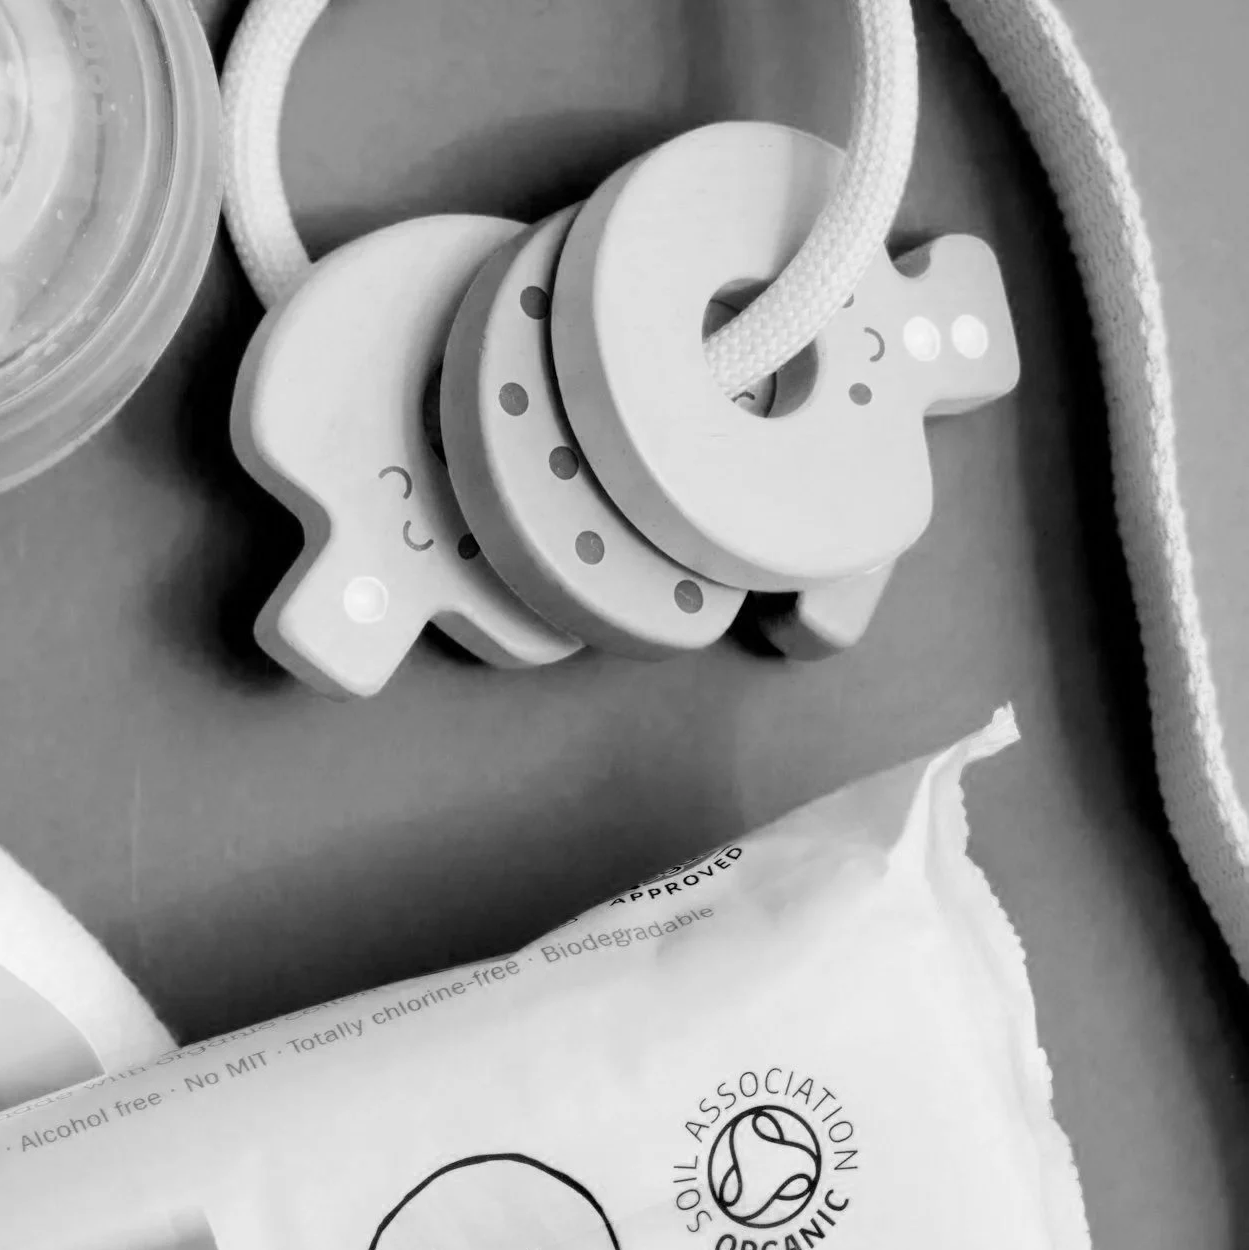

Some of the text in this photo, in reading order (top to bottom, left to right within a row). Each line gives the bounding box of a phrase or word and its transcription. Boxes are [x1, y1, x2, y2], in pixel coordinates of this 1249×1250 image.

[610, 847, 743, 906] APPROVED
[21, 1107, 110, 1152] Alcohol
[115, 1090, 163, 1117] free
[183, 1071, 220, 1093] No
[225, 1050, 268, 1078] MIT
[286, 1018, 364, 1055] Totally
[371, 957, 521, 1026] chlorine-free
[540, 907, 715, 964] Biodegradable
[672, 1067, 859, 1233] SOIL ASSOCIATION
